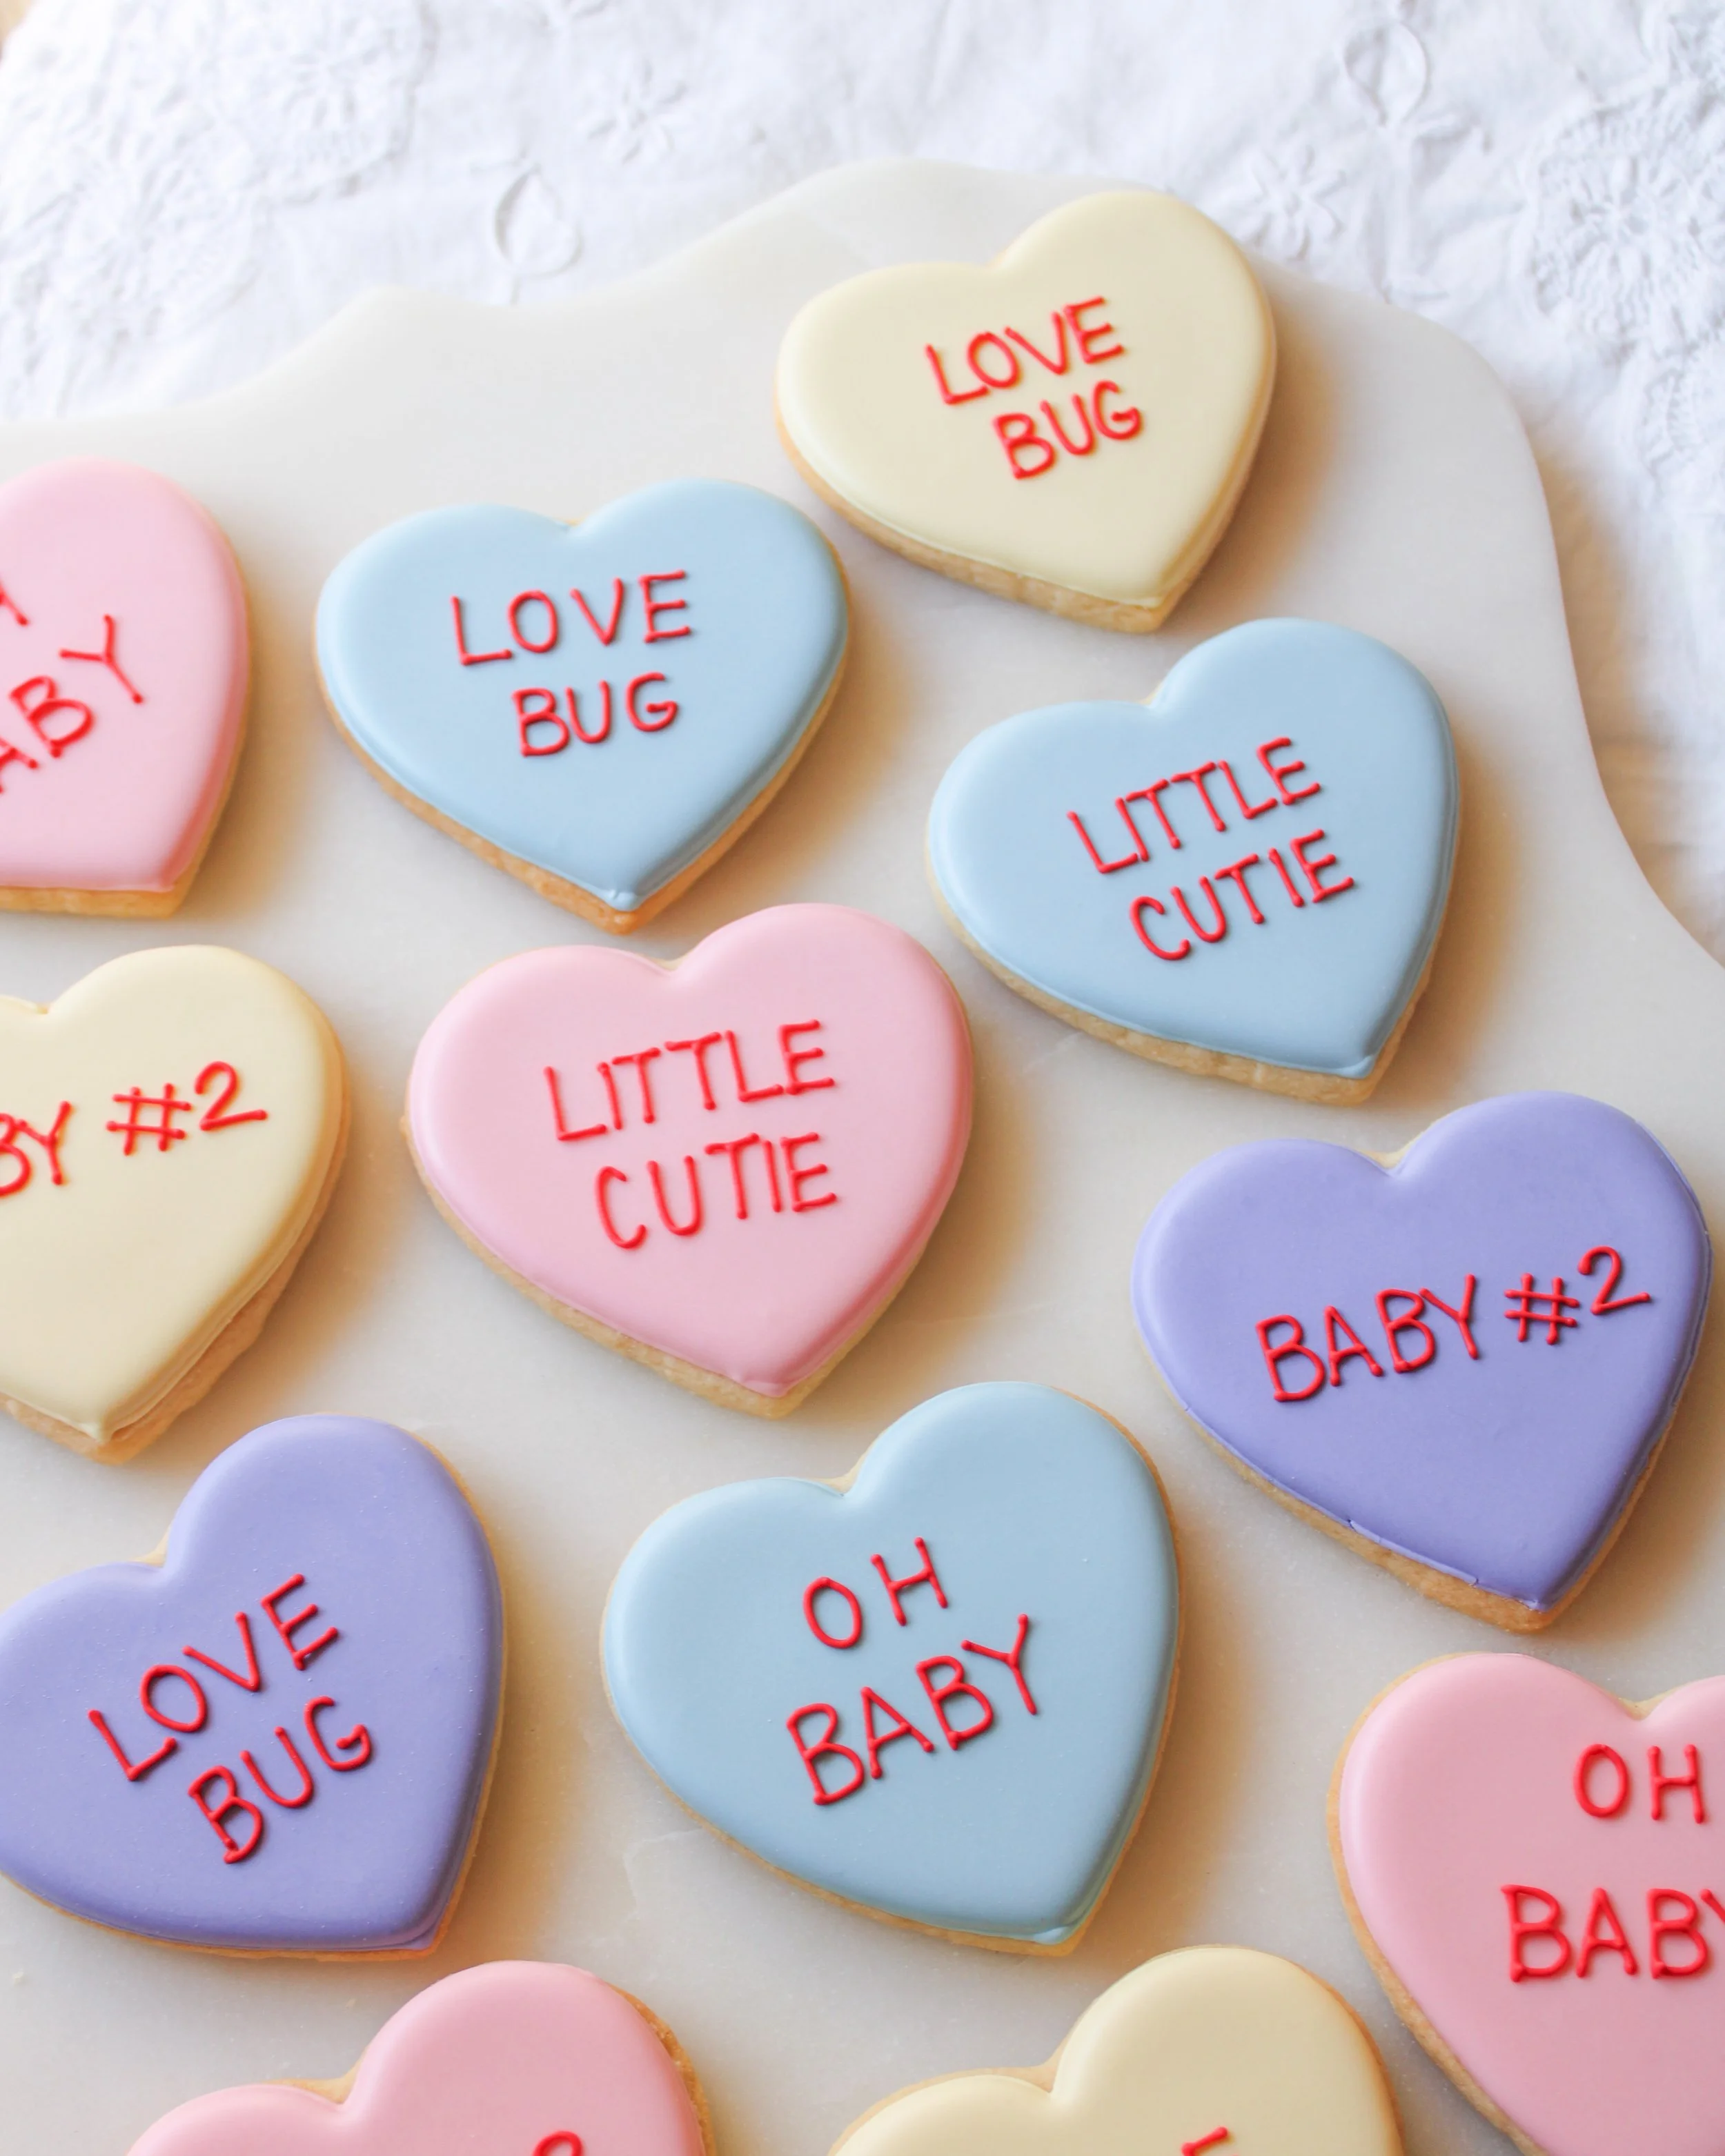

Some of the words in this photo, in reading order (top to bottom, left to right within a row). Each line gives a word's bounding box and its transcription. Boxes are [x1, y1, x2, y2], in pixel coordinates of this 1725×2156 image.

[925, 296, 1124, 406] LOVE
[993, 380, 1142, 479] BUG
[452, 571, 690, 665] LOVE
[513, 673, 678, 756] BUG
[1068, 738, 1319, 874] LITTLE
[1130, 829, 1353, 960] CUTIE
[106, 1061, 268, 1156] #2
[543, 1019, 837, 1143] LITTLE
[595, 1133, 838, 1252] CUTIE
[1256, 1274, 1477, 1401] BABY
[1505, 1246, 1650, 1345] #2
[803, 1538, 947, 1648] OH
[88, 1574, 337, 1781] LOVE
[787, 1614, 1036, 1804] BABY
[188, 1696, 371, 1863] BUG
[1572, 1742, 1711, 1826] OH
